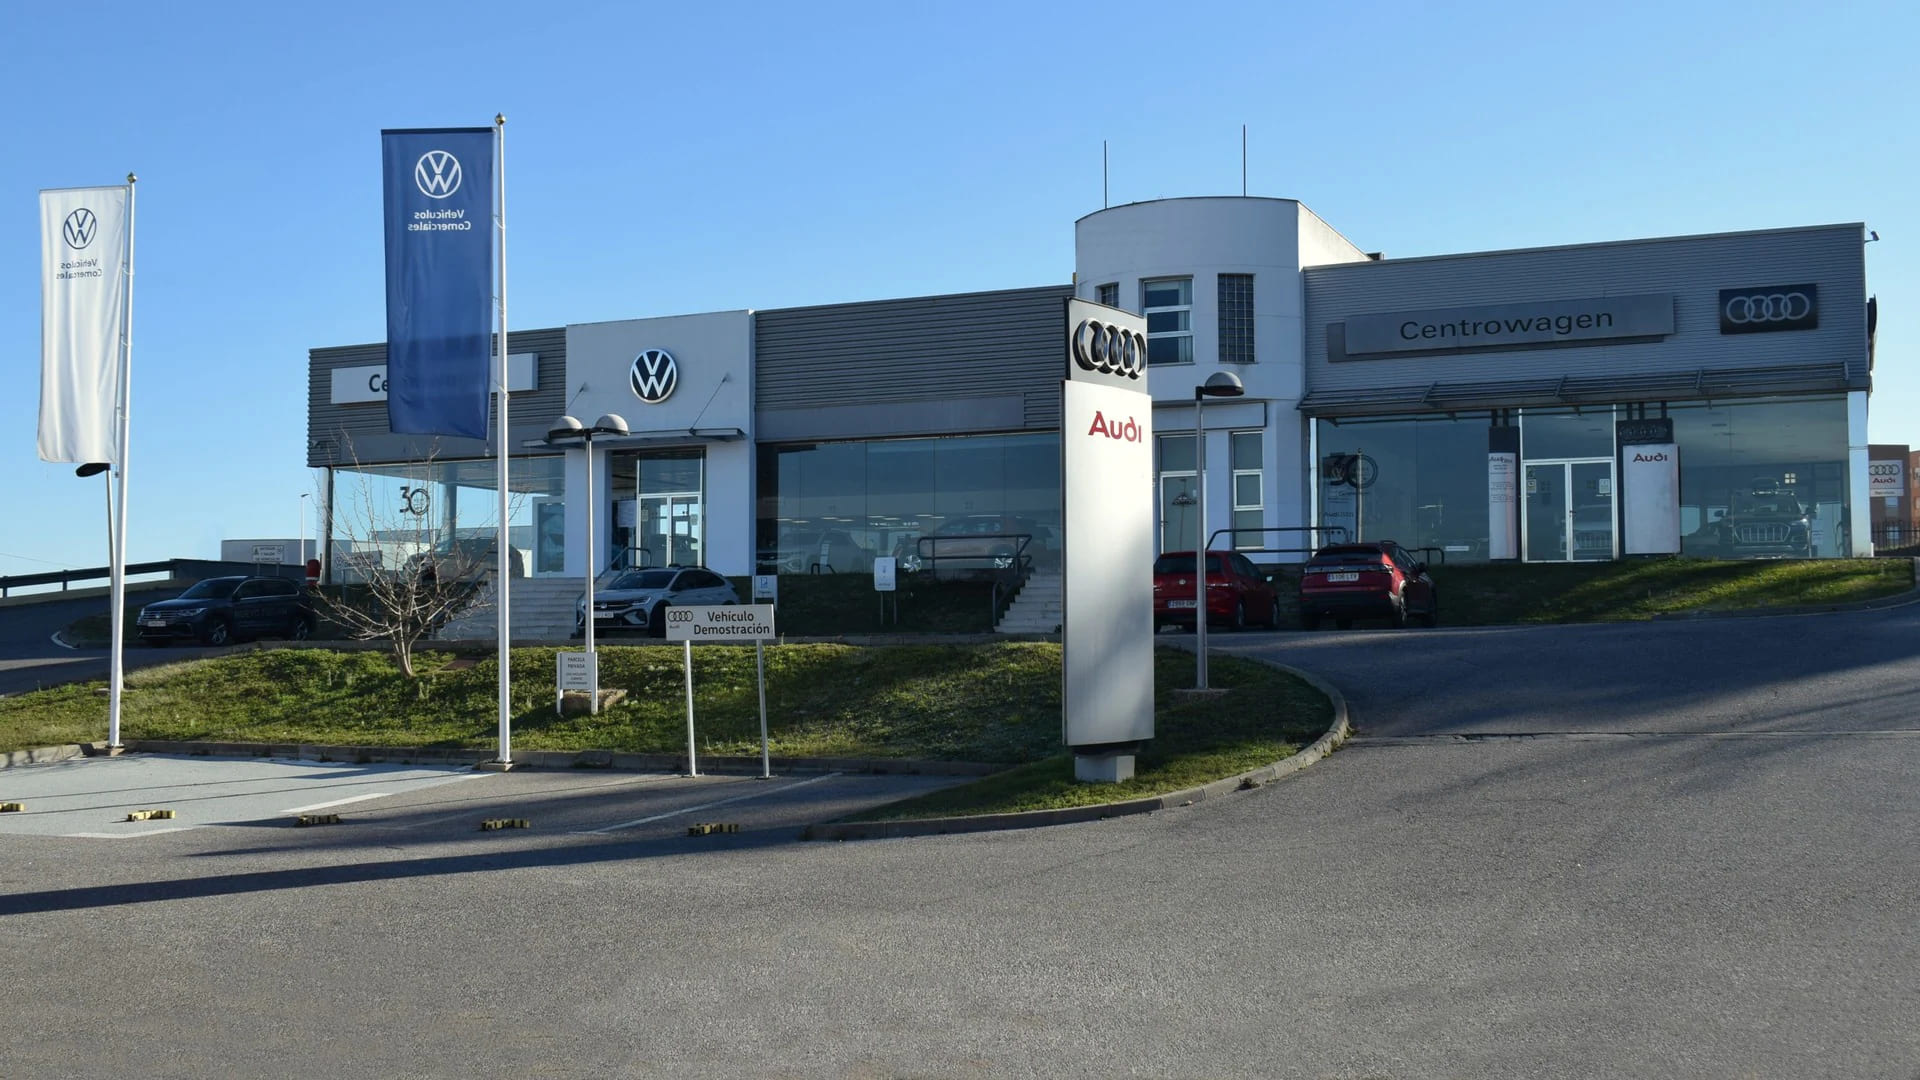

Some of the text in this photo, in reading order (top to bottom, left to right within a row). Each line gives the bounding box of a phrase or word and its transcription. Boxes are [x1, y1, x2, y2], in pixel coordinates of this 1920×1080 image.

[1400, 312, 1613, 340] Centrowagen
[1087, 410, 1142, 443] Audi
[1632, 453, 1668, 462] Audi
[694, 623, 770, 635] Demostración
